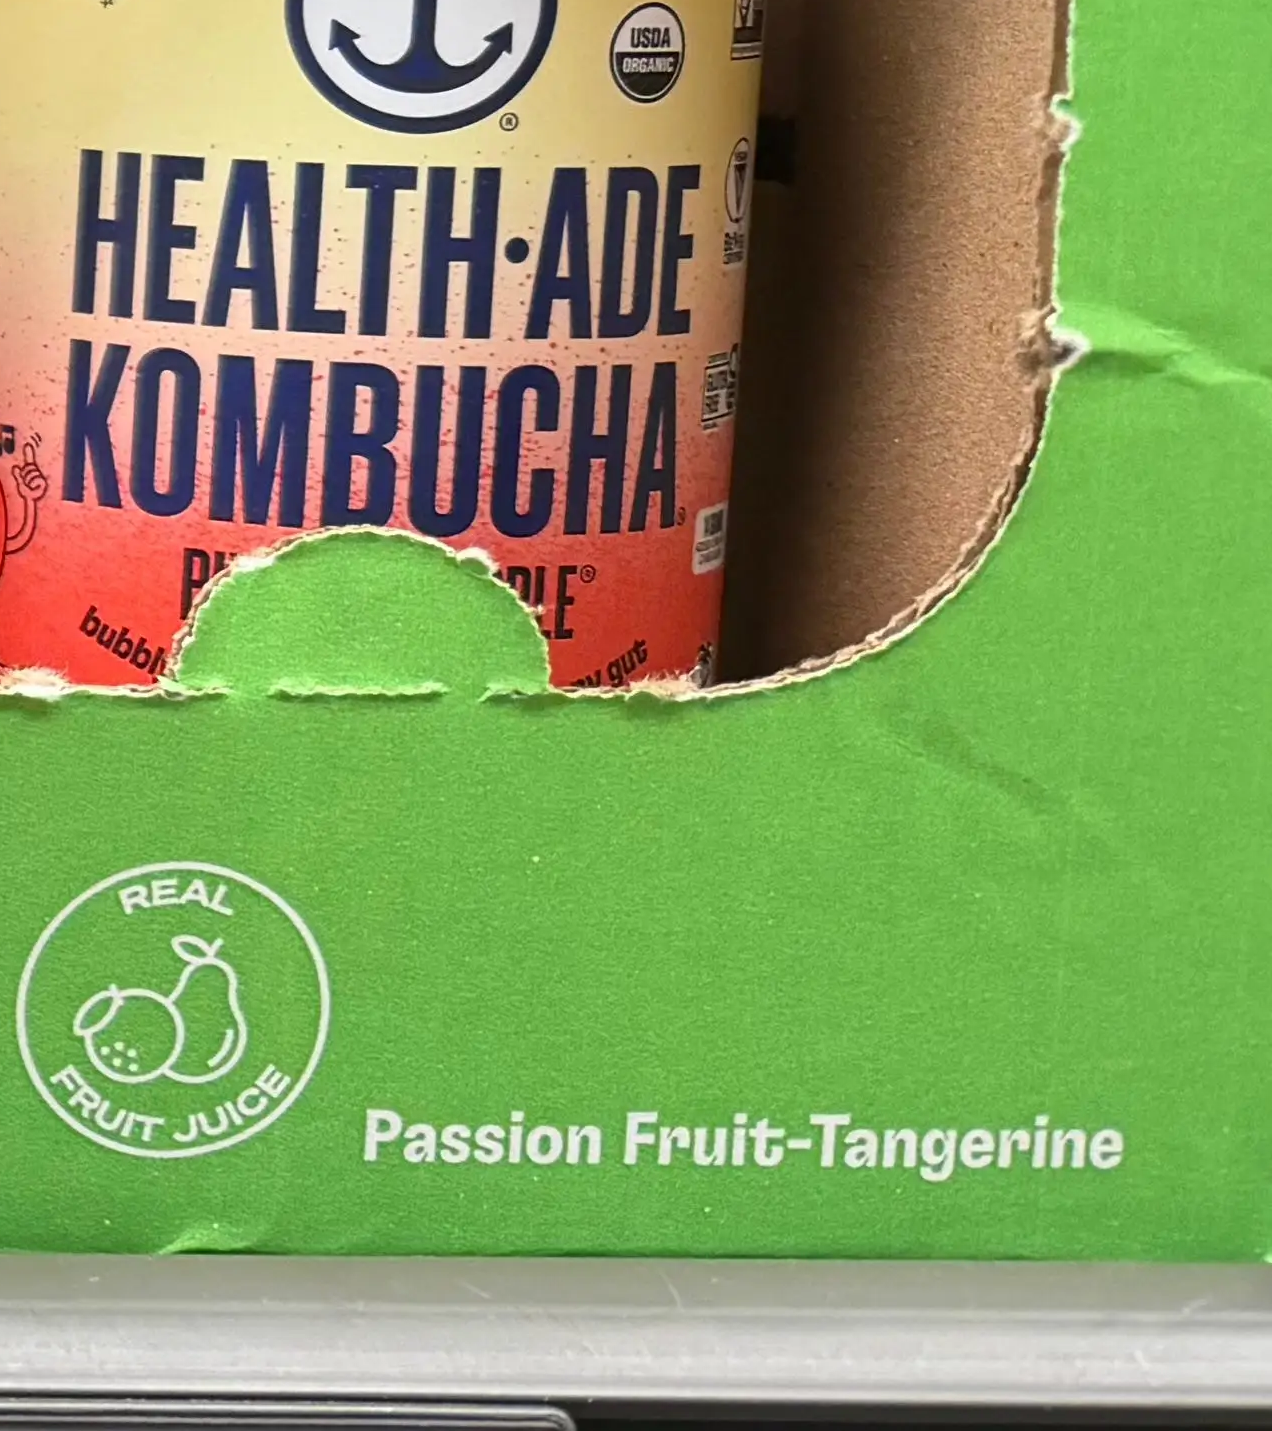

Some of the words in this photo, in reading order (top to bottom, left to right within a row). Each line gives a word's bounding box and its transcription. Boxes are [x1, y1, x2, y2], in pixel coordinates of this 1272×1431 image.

[630, 26, 671, 49] USDA
[622, 56, 675, 74] ORGANIC
[607, 638, 649, 688] gut
[117, 878, 233, 916] REAL
[49, 1063, 165, 1142] FRUIT
[172, 1063, 292, 1143] JUICE
[363, 1108, 602, 1168] Passion
[623, 1110, 1125, 1183] Fruit-Tangerine
